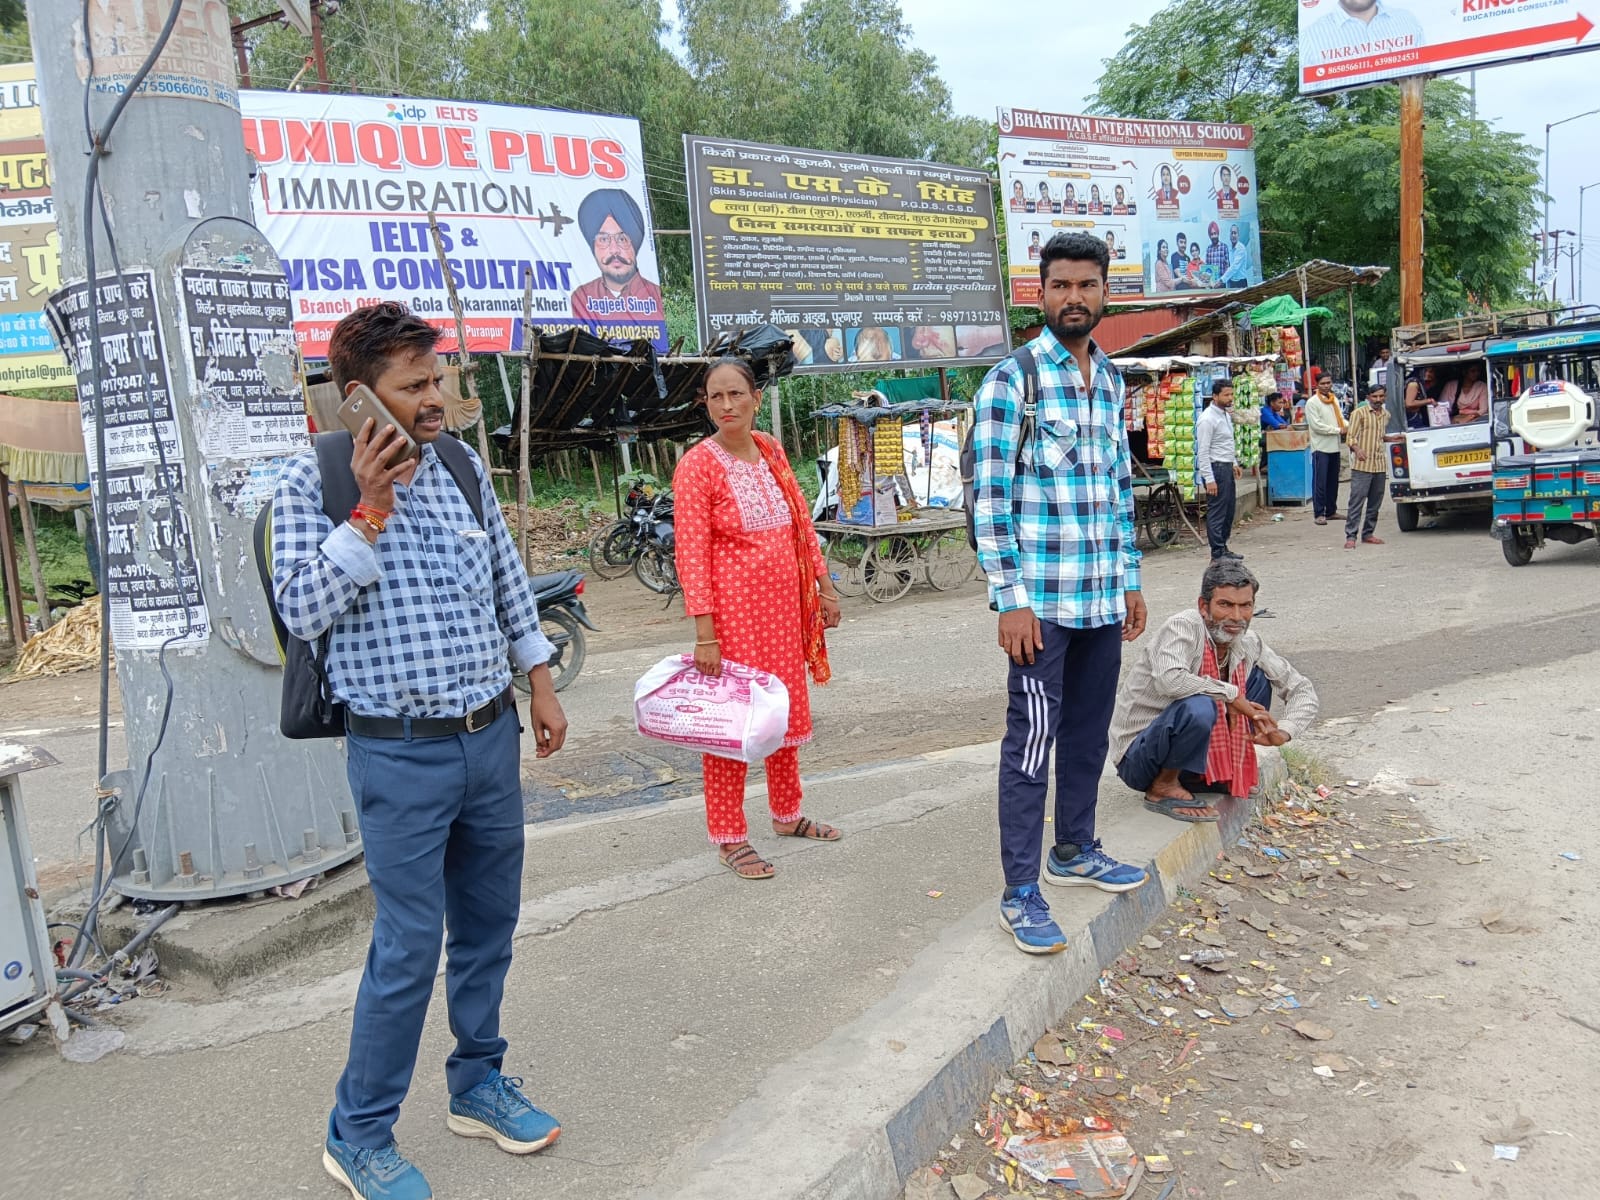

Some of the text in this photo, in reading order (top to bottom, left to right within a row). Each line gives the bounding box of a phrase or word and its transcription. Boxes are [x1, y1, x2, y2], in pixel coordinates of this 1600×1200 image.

[1463, 7, 1515, 22] EDUCATIONAL
[1321, 34, 1413, 59] VIKRAM SINGH
[402, 104, 478, 122] idp IELTS
[1014, 111, 1245, 141] BHARTIYAM INTERNATIONAL SCHOOL
[241, 117, 627, 181] UNIQUE PLUS
[738, 150, 771, 161] प्रकार
[773, 151, 790, 164] की
[905, 168, 920, 177] का
[278, 177, 534, 215] IMMIGRATION
[709, 186, 736, 196] (Skin
[738, 187, 787, 200] Specialist
[789, 191, 829, 202] /General
[831, 195, 878, 207] Physician)
[916, 180, 977, 204] सिंह
[369, 221, 478, 253] IELTS &
[736, 217, 777, 230] निम्न
[860, 225, 881, 235] का
[280, 258, 572, 291] VISA CONSULTANT
[709, 280, 739, 291] मिलने
[742, 282, 756, 291] का
[822, 282, 832, 291] 10
[128, 276, 149, 299] करें
[219, 279, 249, 298] ताकत
[300, 298, 352, 314] Branch
[412, 297, 443, 312] Gola
[587, 296, 657, 314] Jagjeet Singh
[709, 313, 734, 330] सुपर
[770, 309, 800, 325] मैजिक
[832, 310, 863, 327] पूरनपुर
[872, 308, 903, 322] सम्पर्क
[906, 307, 923, 322] करें
[940, 311, 1001, 322] 9897131278
[465, 324, 504, 339] Puranpur
[596, 325, 660, 340] 9548002565
